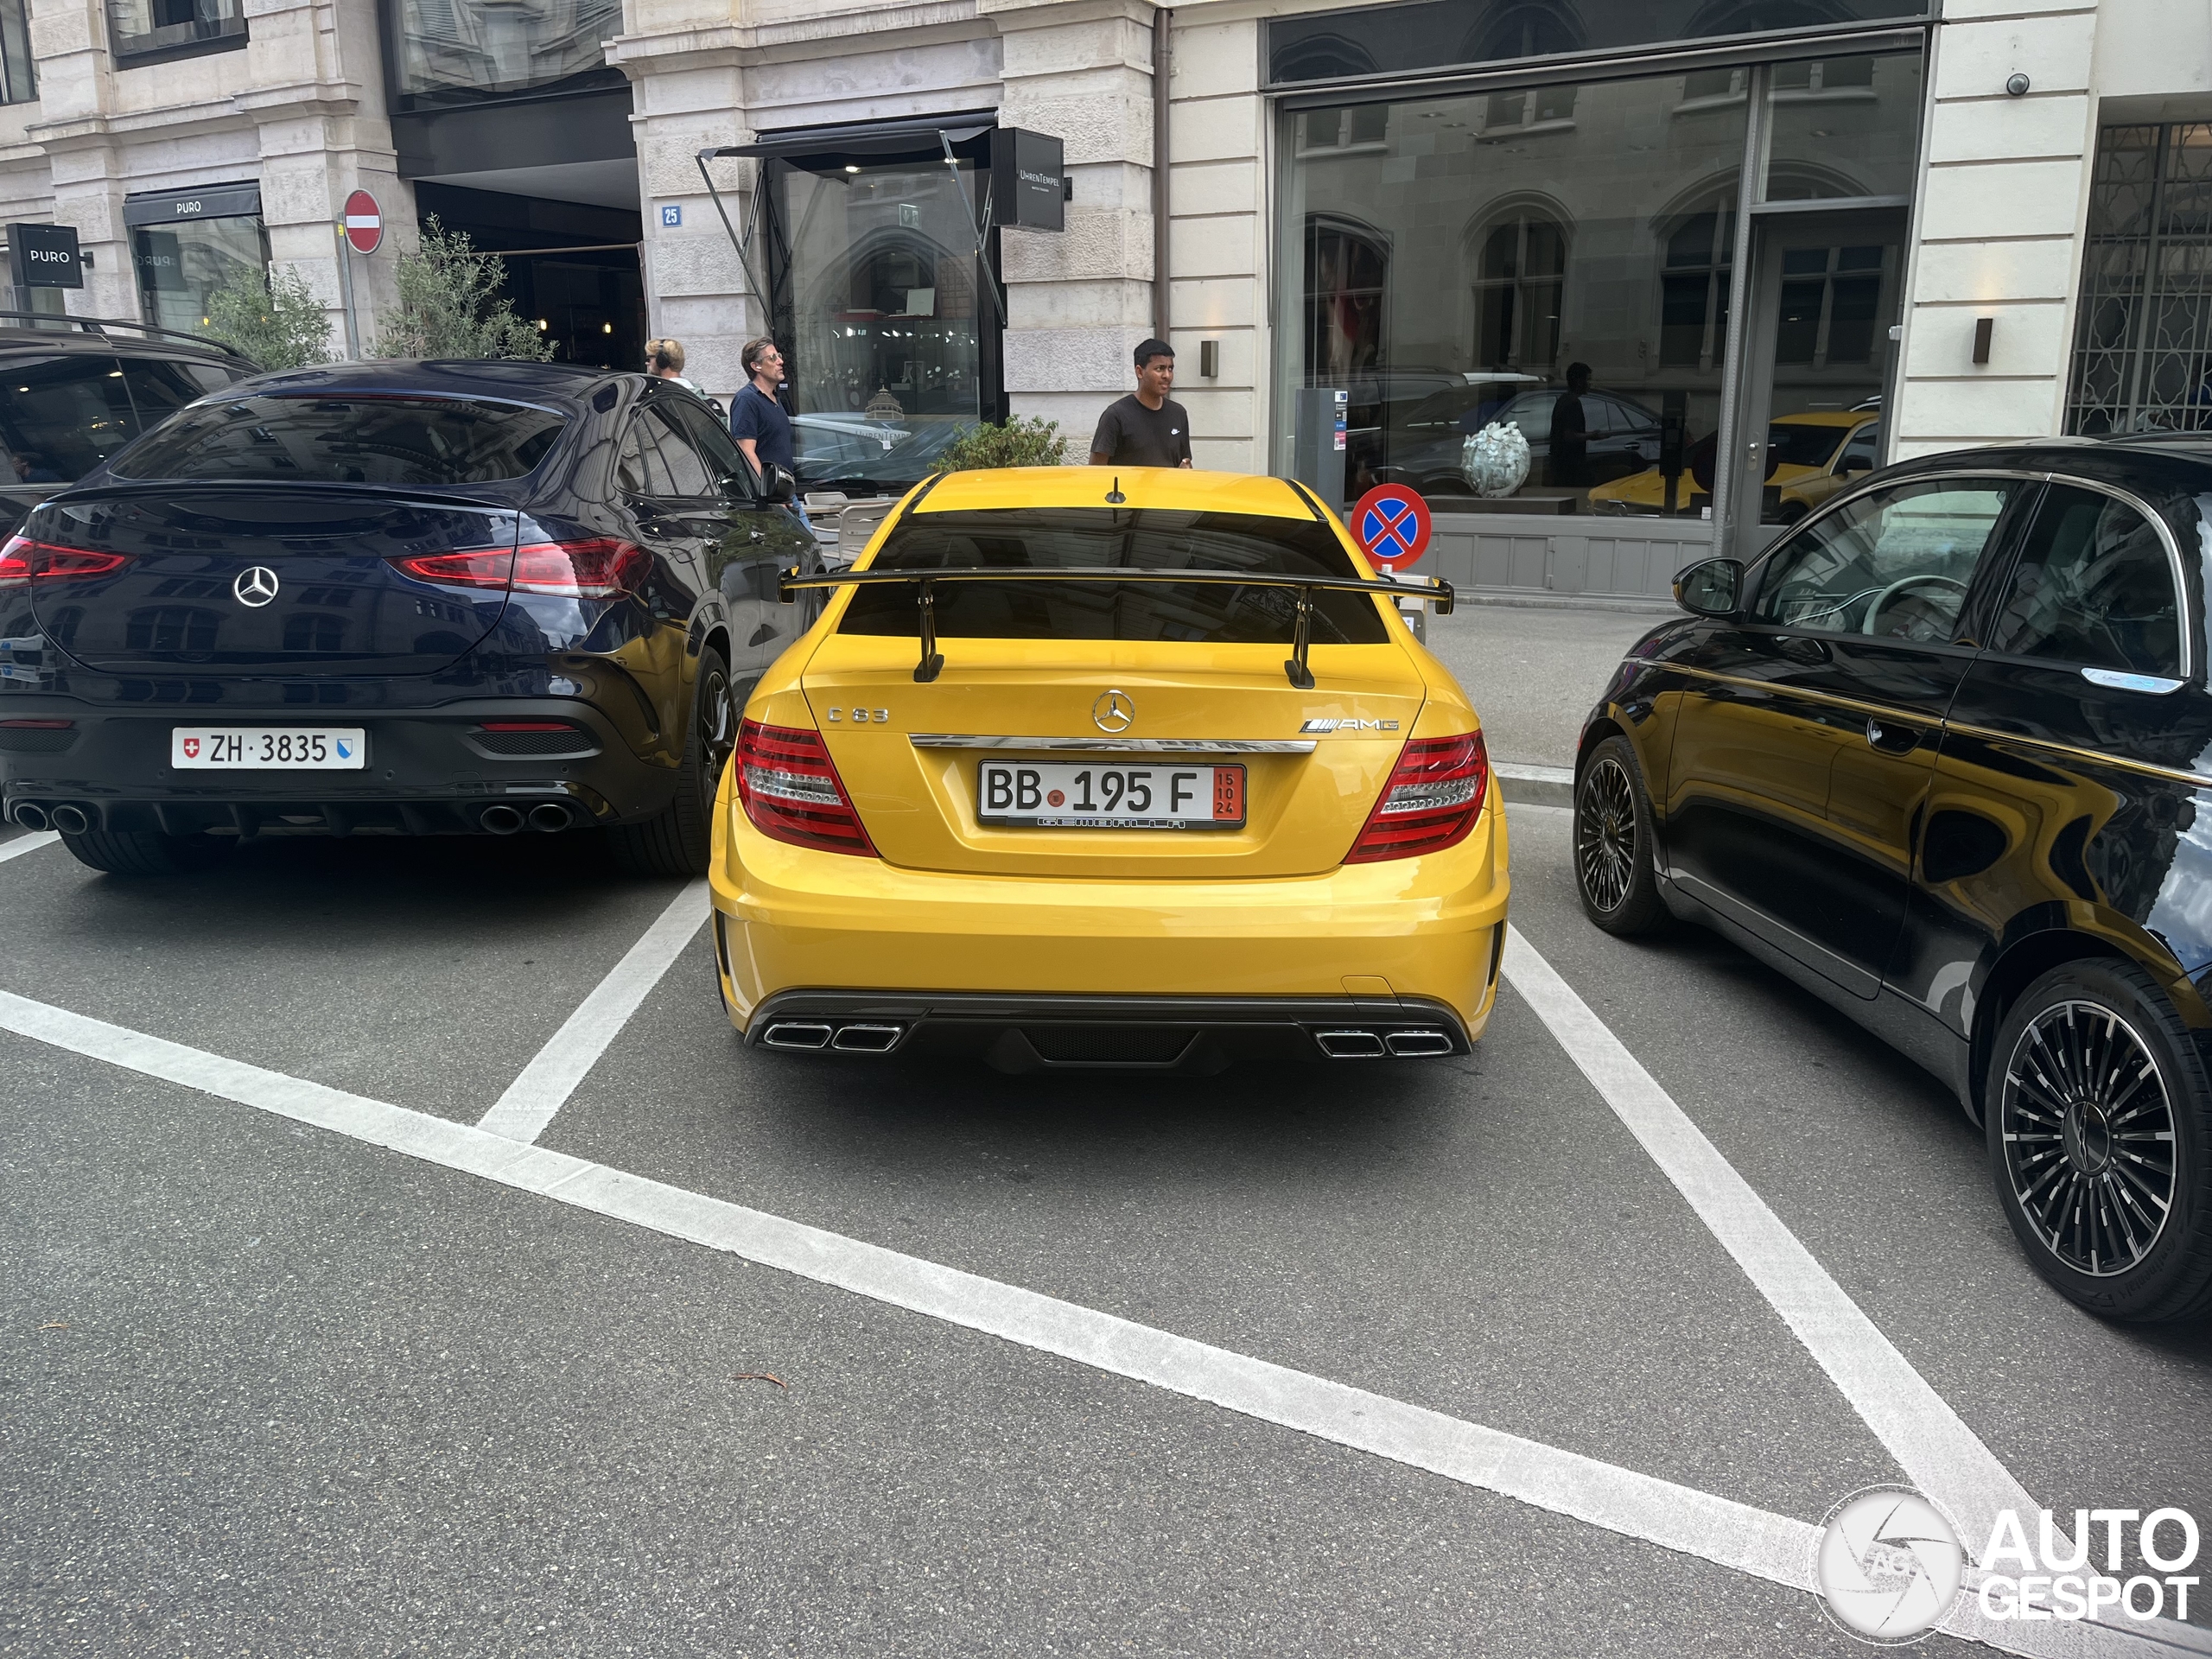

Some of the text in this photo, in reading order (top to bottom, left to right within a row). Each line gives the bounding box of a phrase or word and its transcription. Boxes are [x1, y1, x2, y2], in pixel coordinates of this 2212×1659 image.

[176, 200, 201, 214] PURO
[664, 207, 678, 225] 25
[29, 249, 70, 264] PURO
[828, 707, 889, 723] C 63
[1336, 718, 1400, 731] AMG
[259, 734, 327, 762] 3835
[1217, 772, 1234, 785] 15
[988, 769, 1198, 813] BB 195 F
[1217, 787, 1234, 799] 10
[1216, 802, 1234, 814] 24
[1037, 817, 1186, 830] GEMBALLA
